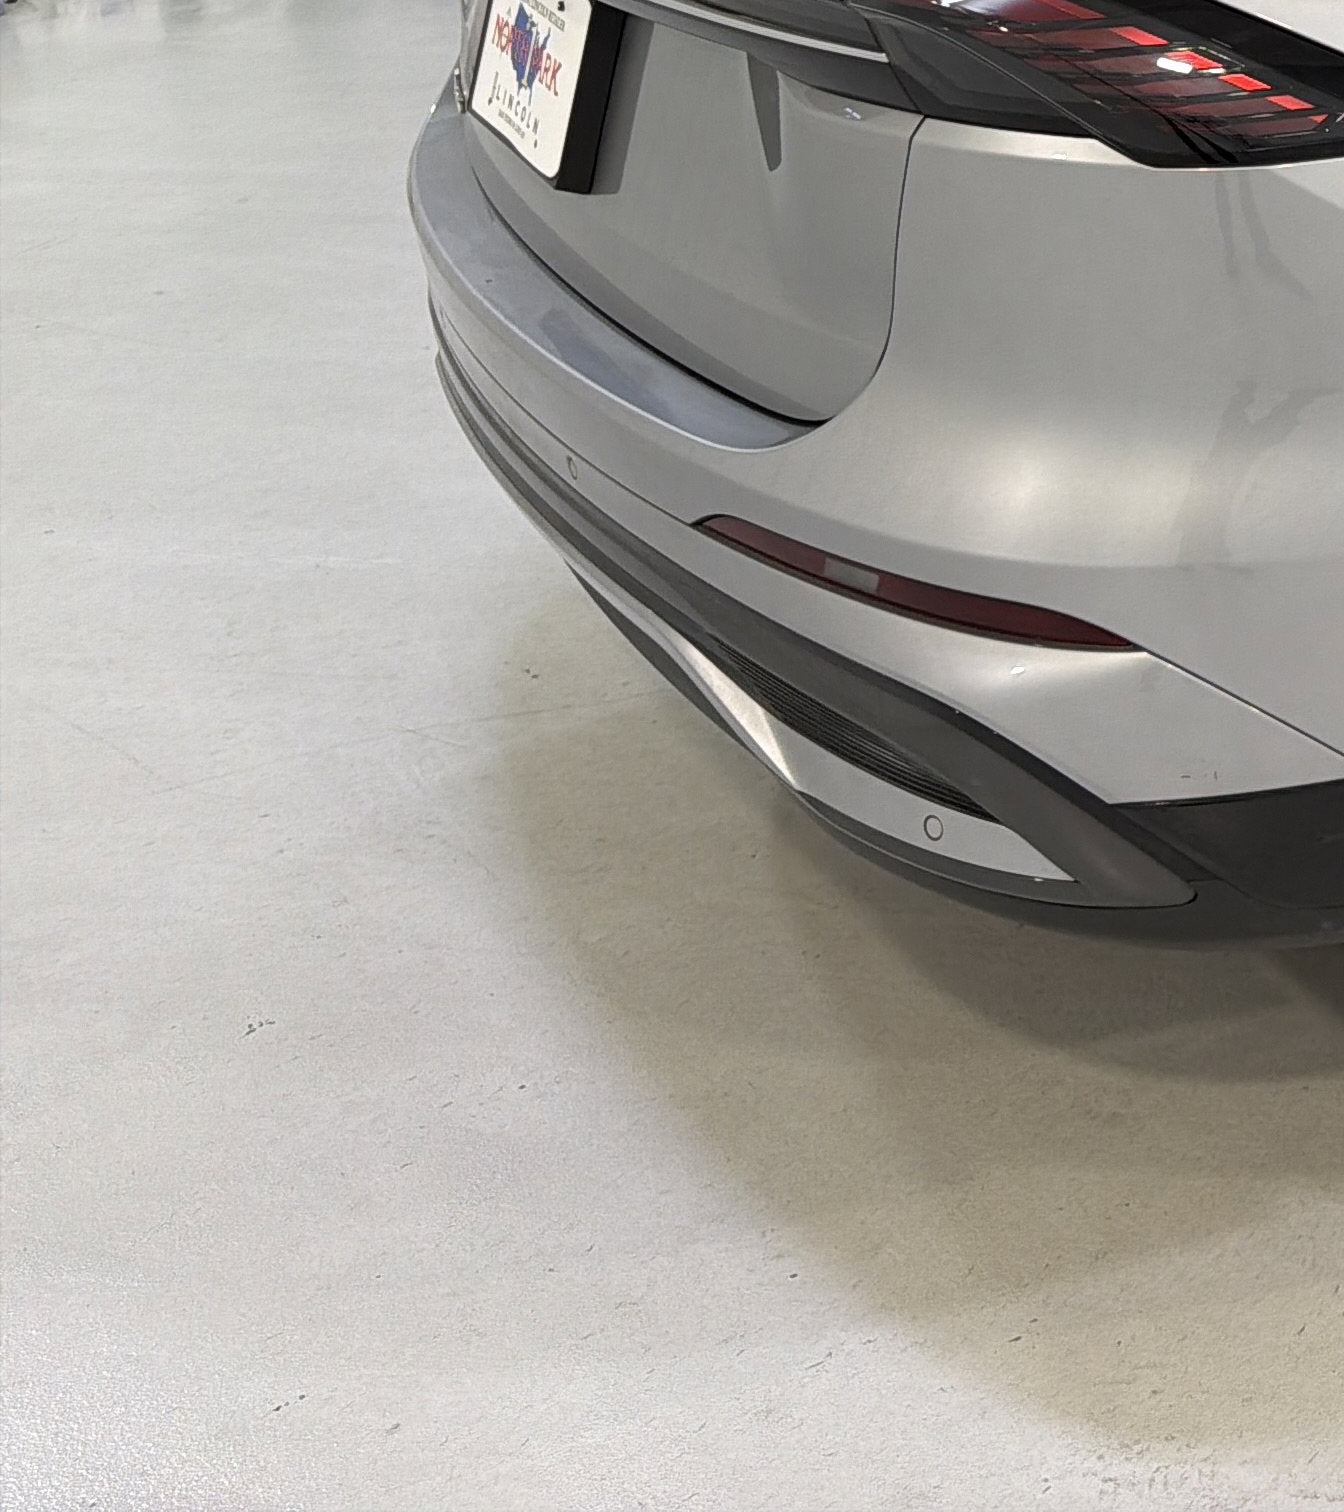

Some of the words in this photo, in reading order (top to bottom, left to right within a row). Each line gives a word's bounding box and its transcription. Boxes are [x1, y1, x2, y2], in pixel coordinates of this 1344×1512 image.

[491, 13, 532, 68] NORTH
[532, 42, 563, 97] PARK
[496, 84, 540, 136] LINCOLN
